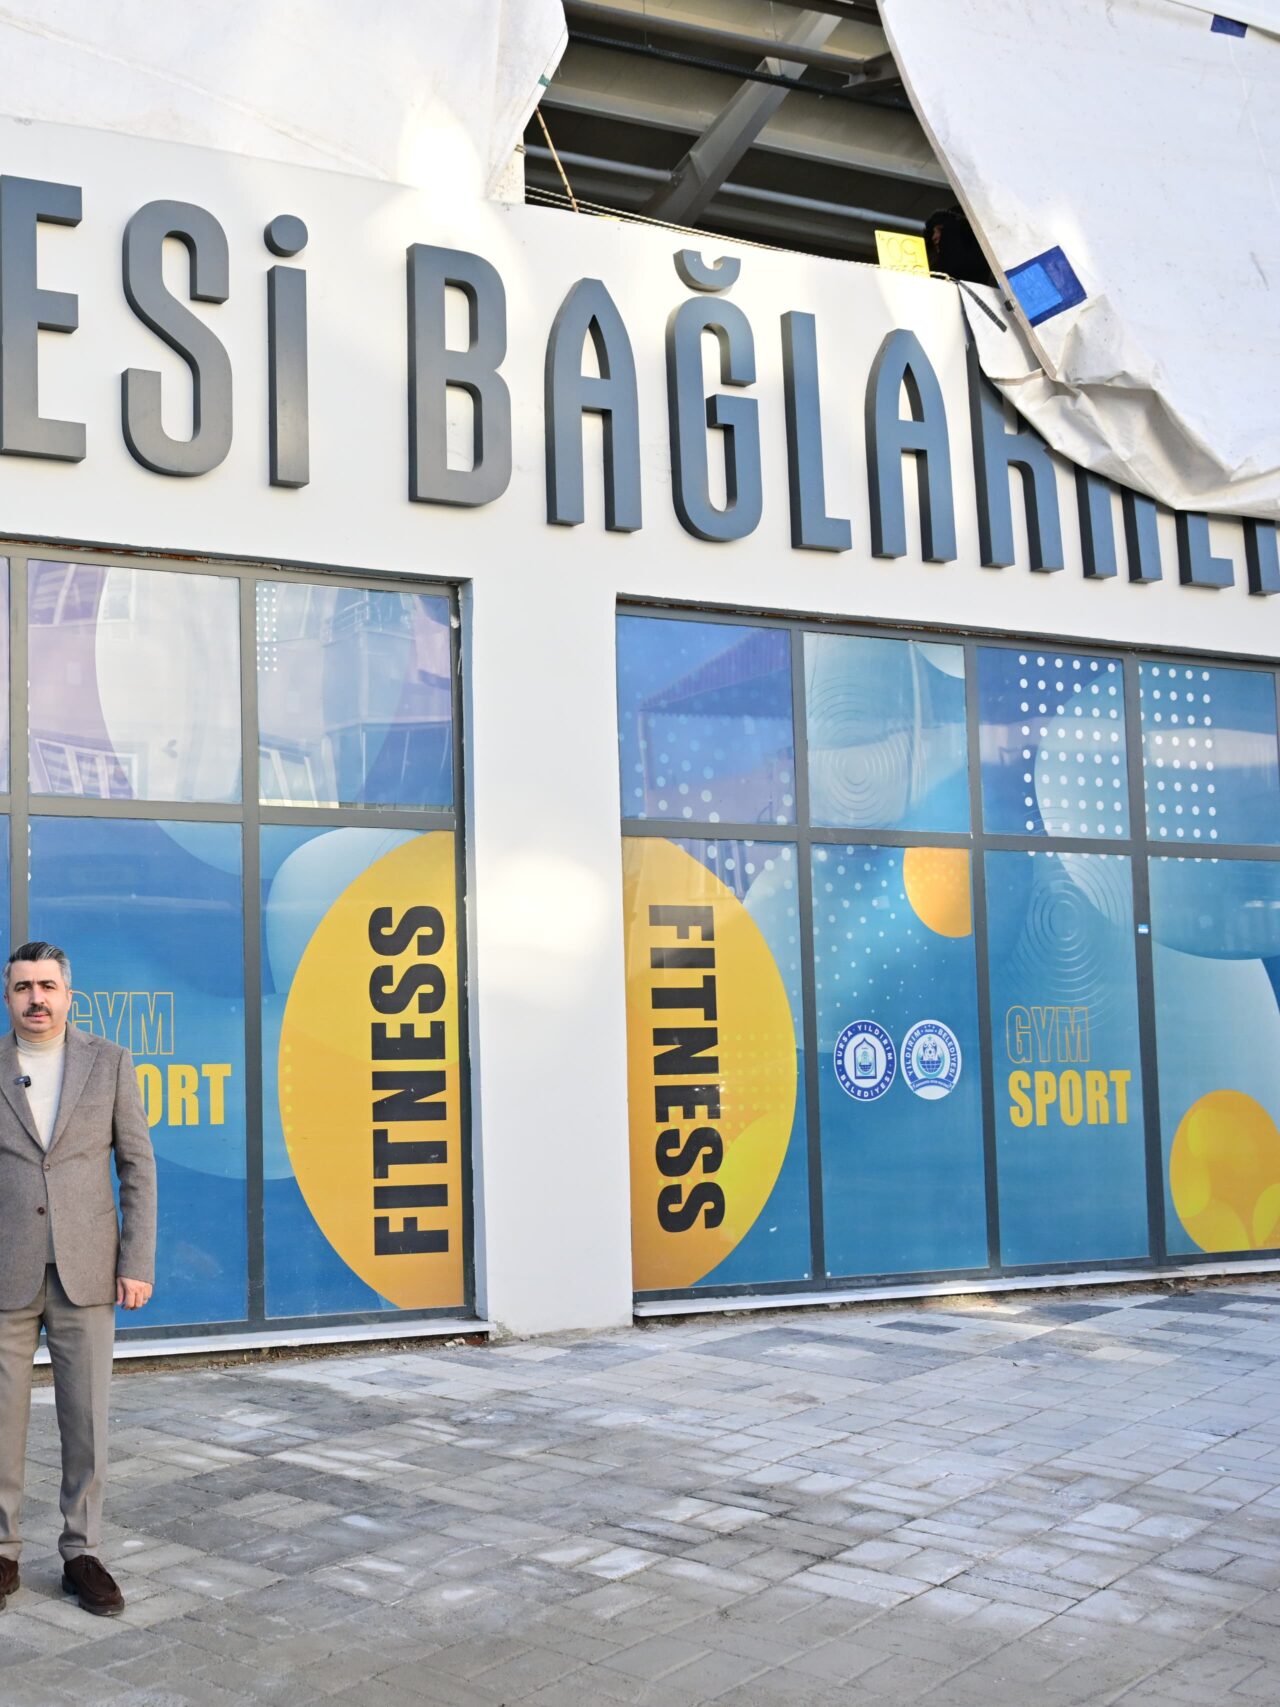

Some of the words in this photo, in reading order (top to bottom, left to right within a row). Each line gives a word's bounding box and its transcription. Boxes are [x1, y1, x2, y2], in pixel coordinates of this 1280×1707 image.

[406, 243, 1280, 597] BAĞLAR
[134, 1063, 232, 1128] ORT
[368, 905, 449, 1256] FITNESS
[648, 904, 726, 1233] FITNESS
[1005, 1005, 1091, 1063] GYM
[1008, 1069, 1132, 1128] SPORT
